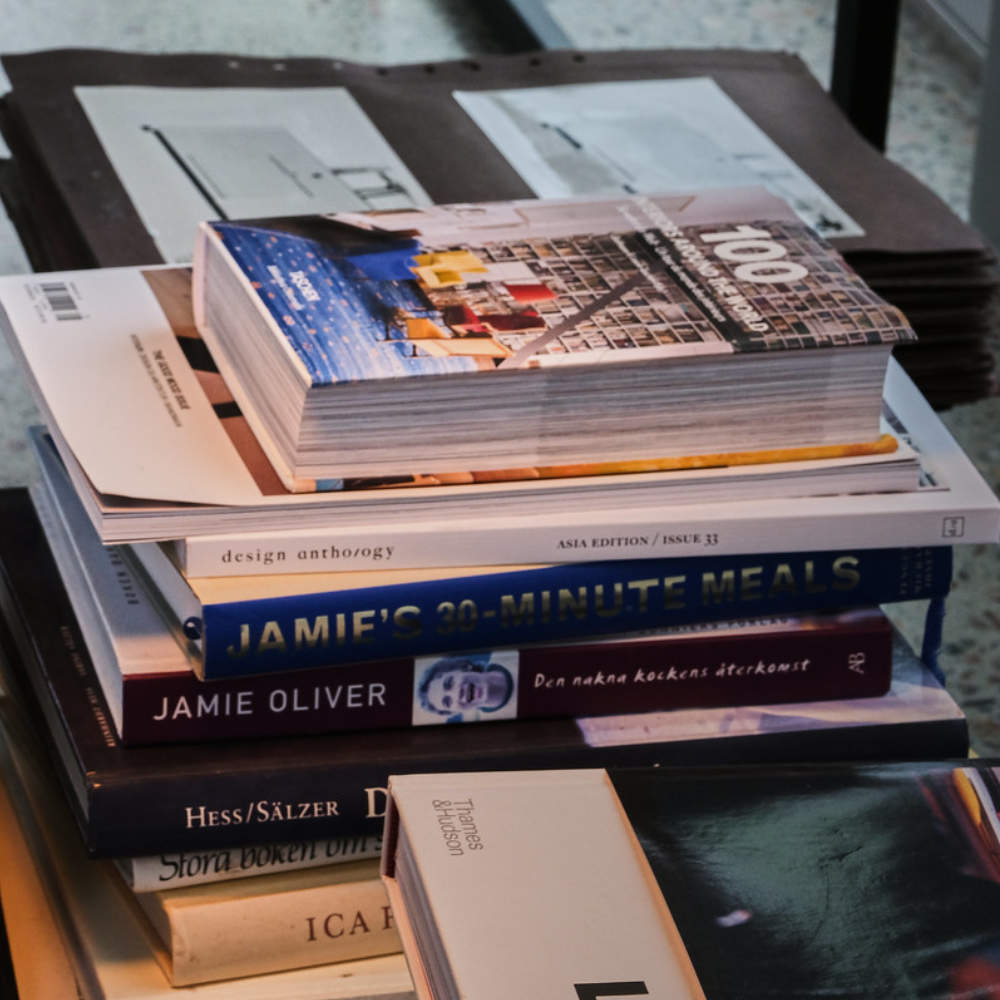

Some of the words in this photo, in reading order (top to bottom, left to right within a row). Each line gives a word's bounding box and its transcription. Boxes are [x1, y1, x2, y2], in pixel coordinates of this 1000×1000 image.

[699, 224, 809, 284] 100
[221, 548, 286, 565] design
[297, 544, 395, 561] anthology
[556, 538, 588, 549] ASIA
[591, 536, 649, 548] EDITION
[662, 533, 701, 545] ISSUE
[704, 533, 719, 546] 33
[226, 605, 423, 657] JAMIE'S
[702, 556, 861, 607] MEALS
[534, 673, 565, 689] Den
[572, 671, 626, 687] nakna
[634, 665, 708, 684] kockens
[714, 658, 810, 679] återkomst
[153, 691, 254, 721] JAMIE
[269, 683, 387, 713] OLIVER
[432, 799, 464, 857] &Hudson
[454, 798, 483, 852] Thames
[159, 850, 232, 882] Stora
[306, 910, 371, 943] ICA
